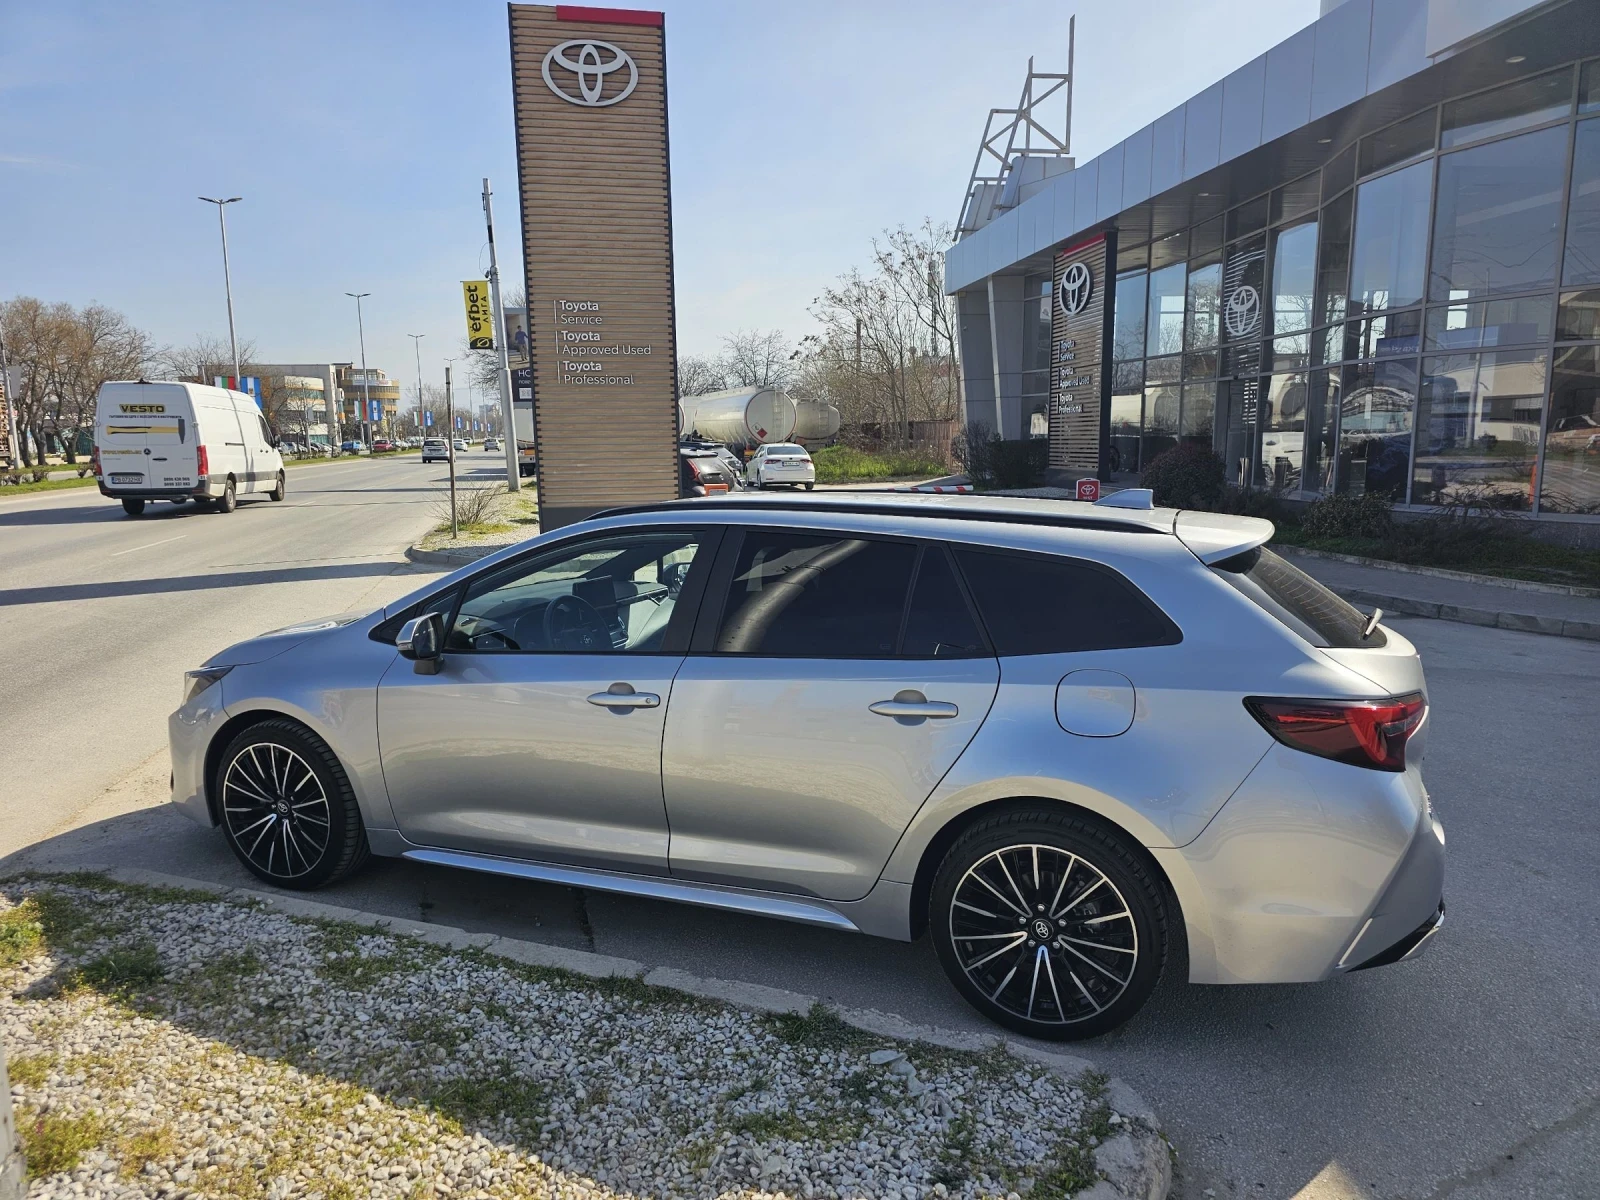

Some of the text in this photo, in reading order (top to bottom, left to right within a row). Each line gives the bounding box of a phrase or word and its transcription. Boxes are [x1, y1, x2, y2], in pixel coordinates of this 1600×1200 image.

[466, 284, 482, 332] efbet
[559, 300, 599, 312] Toyota
[560, 313, 602, 325] Service
[561, 330, 601, 343] Toyota
[562, 344, 651, 357] Approved Used
[1060, 340, 1076, 351] Toyota
[562, 360, 602, 373] Toyota
[1059, 366, 1074, 377] Toyota
[564, 374, 635, 385] Professional
[1059, 392, 1073, 404] Toyota
[120, 404, 166, 414] VESTO
